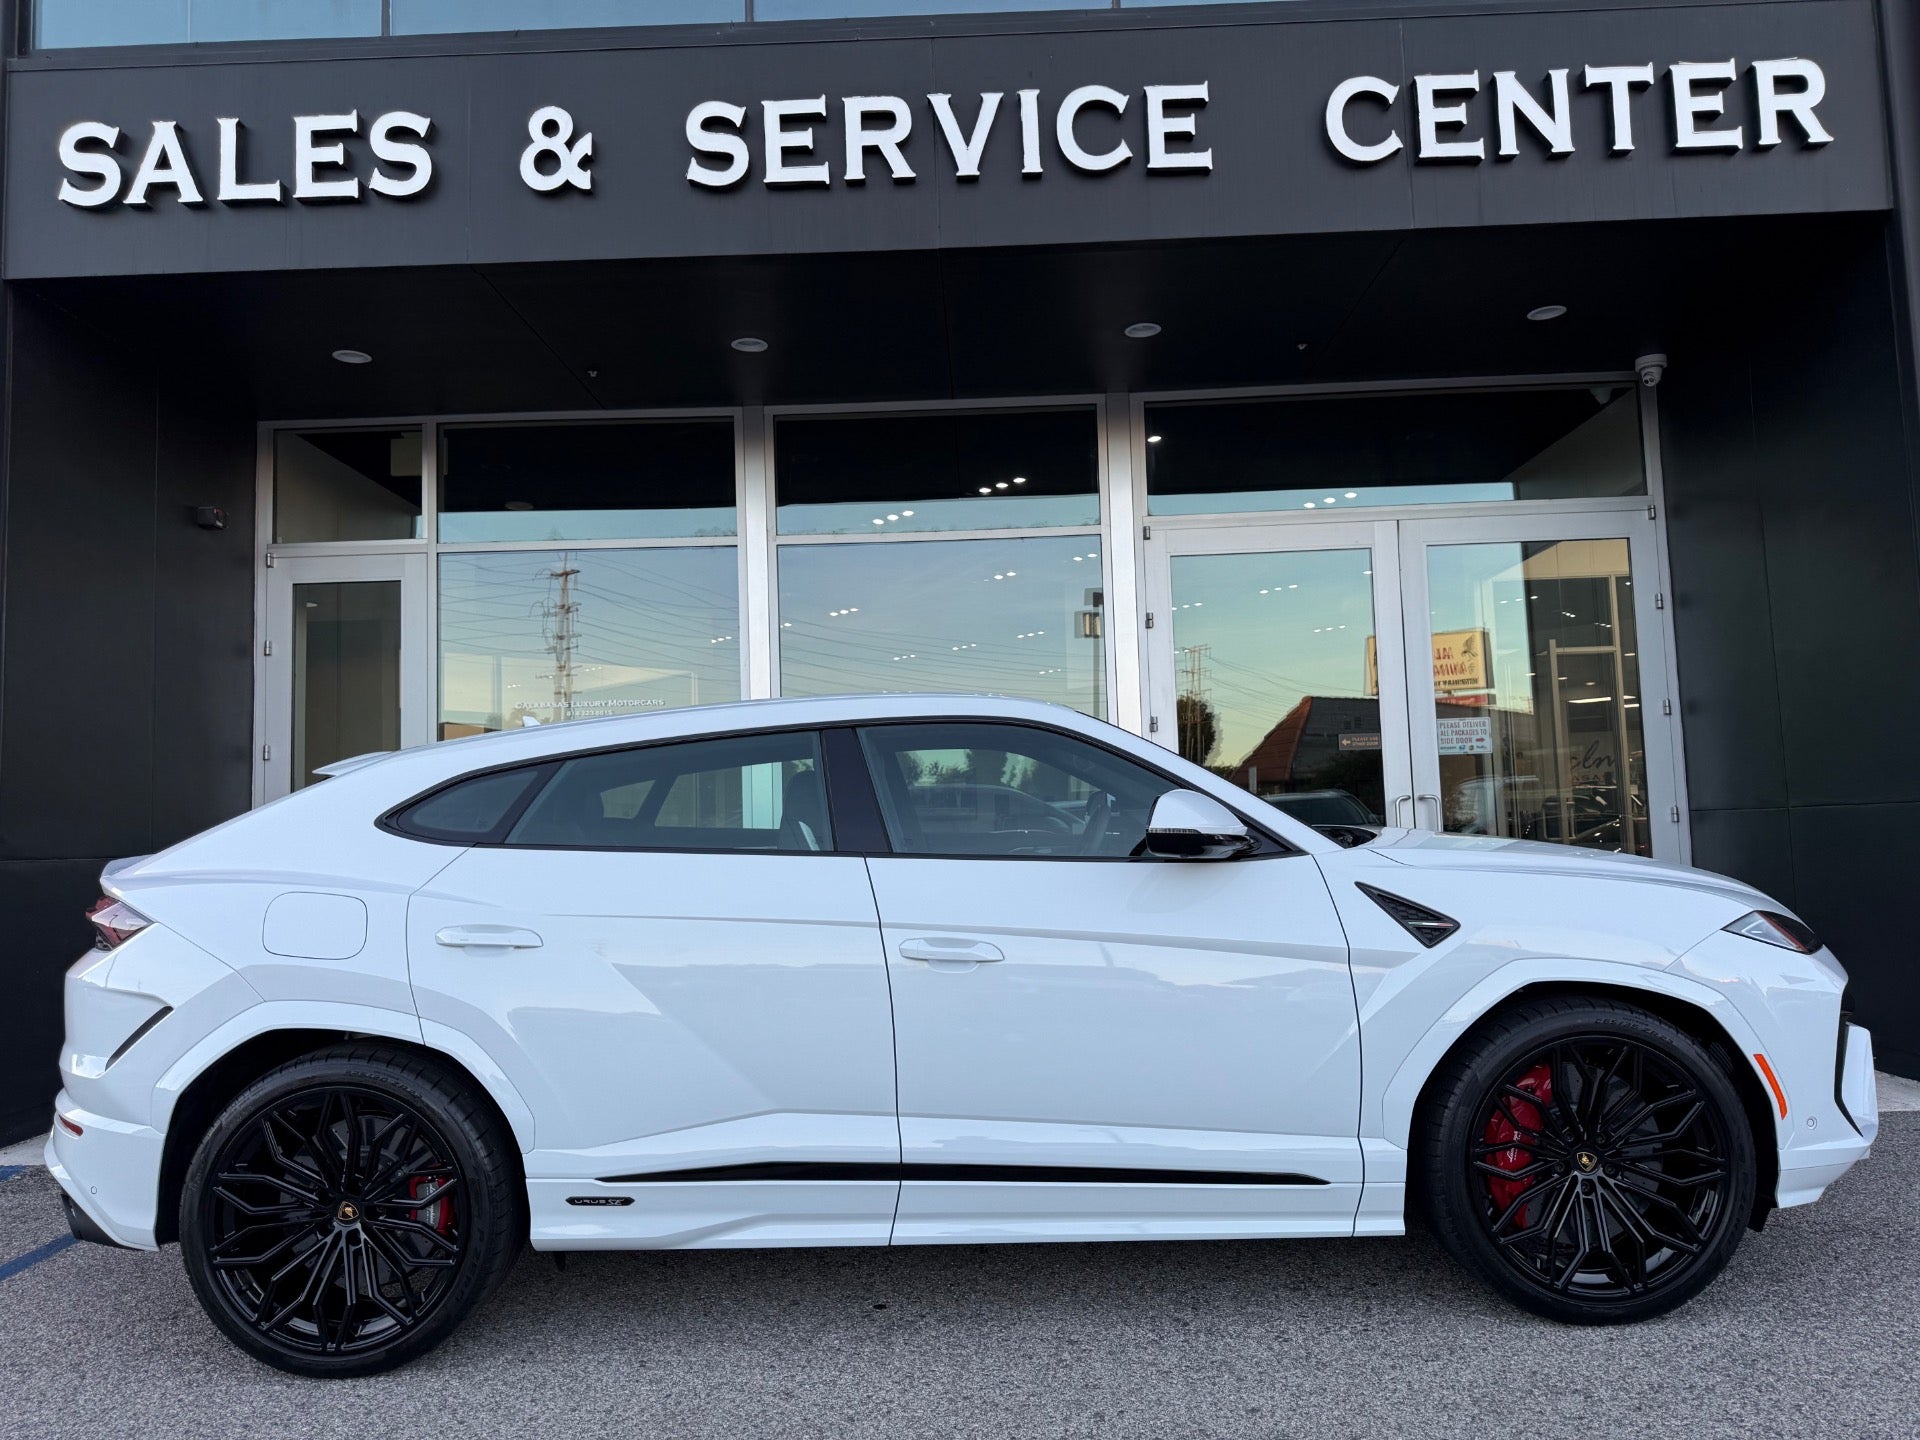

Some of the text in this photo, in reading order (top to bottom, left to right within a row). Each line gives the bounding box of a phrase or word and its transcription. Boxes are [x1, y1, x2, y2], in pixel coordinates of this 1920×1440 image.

[57, 56, 1835, 208] SALES & SERVICE CENTER
[571, 700, 607, 709] LUXURY
[608, 699, 665, 708] MOTORCARS
[1440, 720, 1487, 729] PLEASE DELIVER
[1451, 729, 1479, 737] PACKAGES
